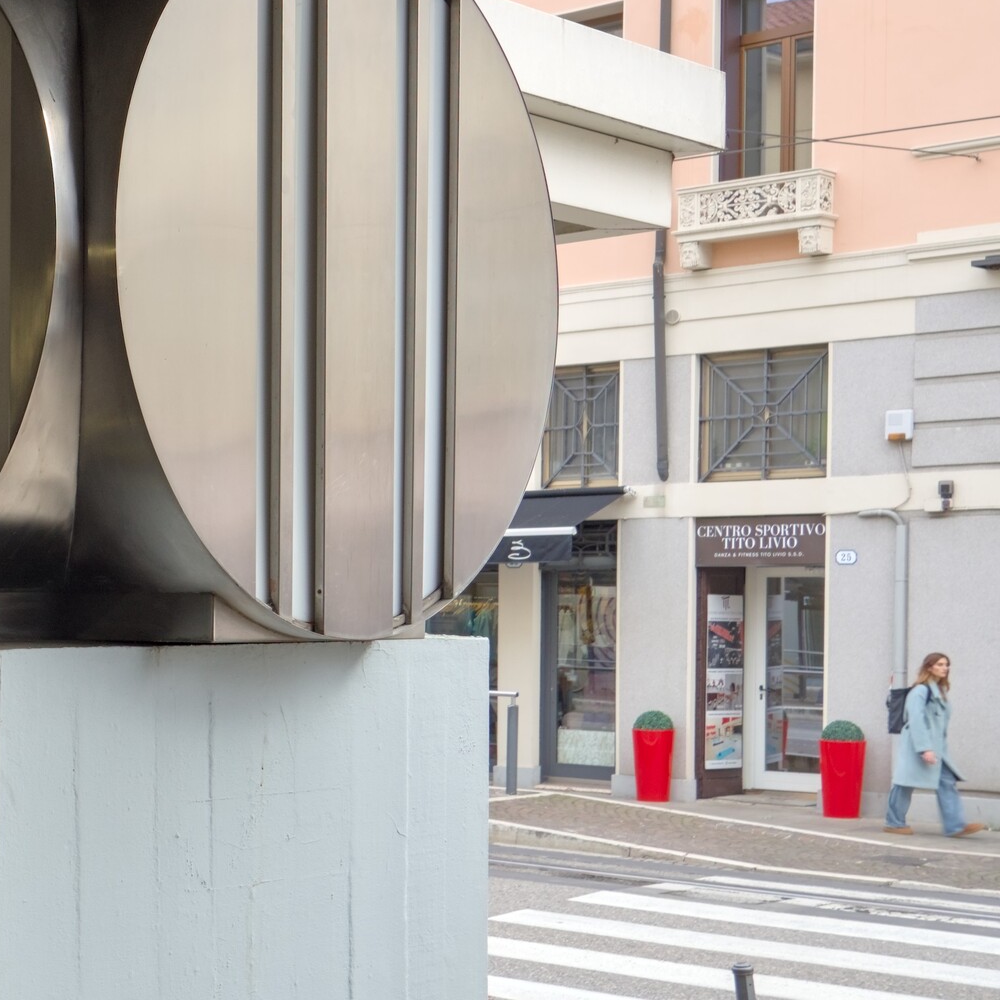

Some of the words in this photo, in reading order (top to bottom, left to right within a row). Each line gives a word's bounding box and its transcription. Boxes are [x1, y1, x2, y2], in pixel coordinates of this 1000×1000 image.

[696, 524, 751, 538] CENTRO
[754, 522, 826, 537] SPORTIVO
[721, 537, 756, 550] TITO
[759, 536, 798, 549] LIVIO
[840, 552, 852, 562] 25
